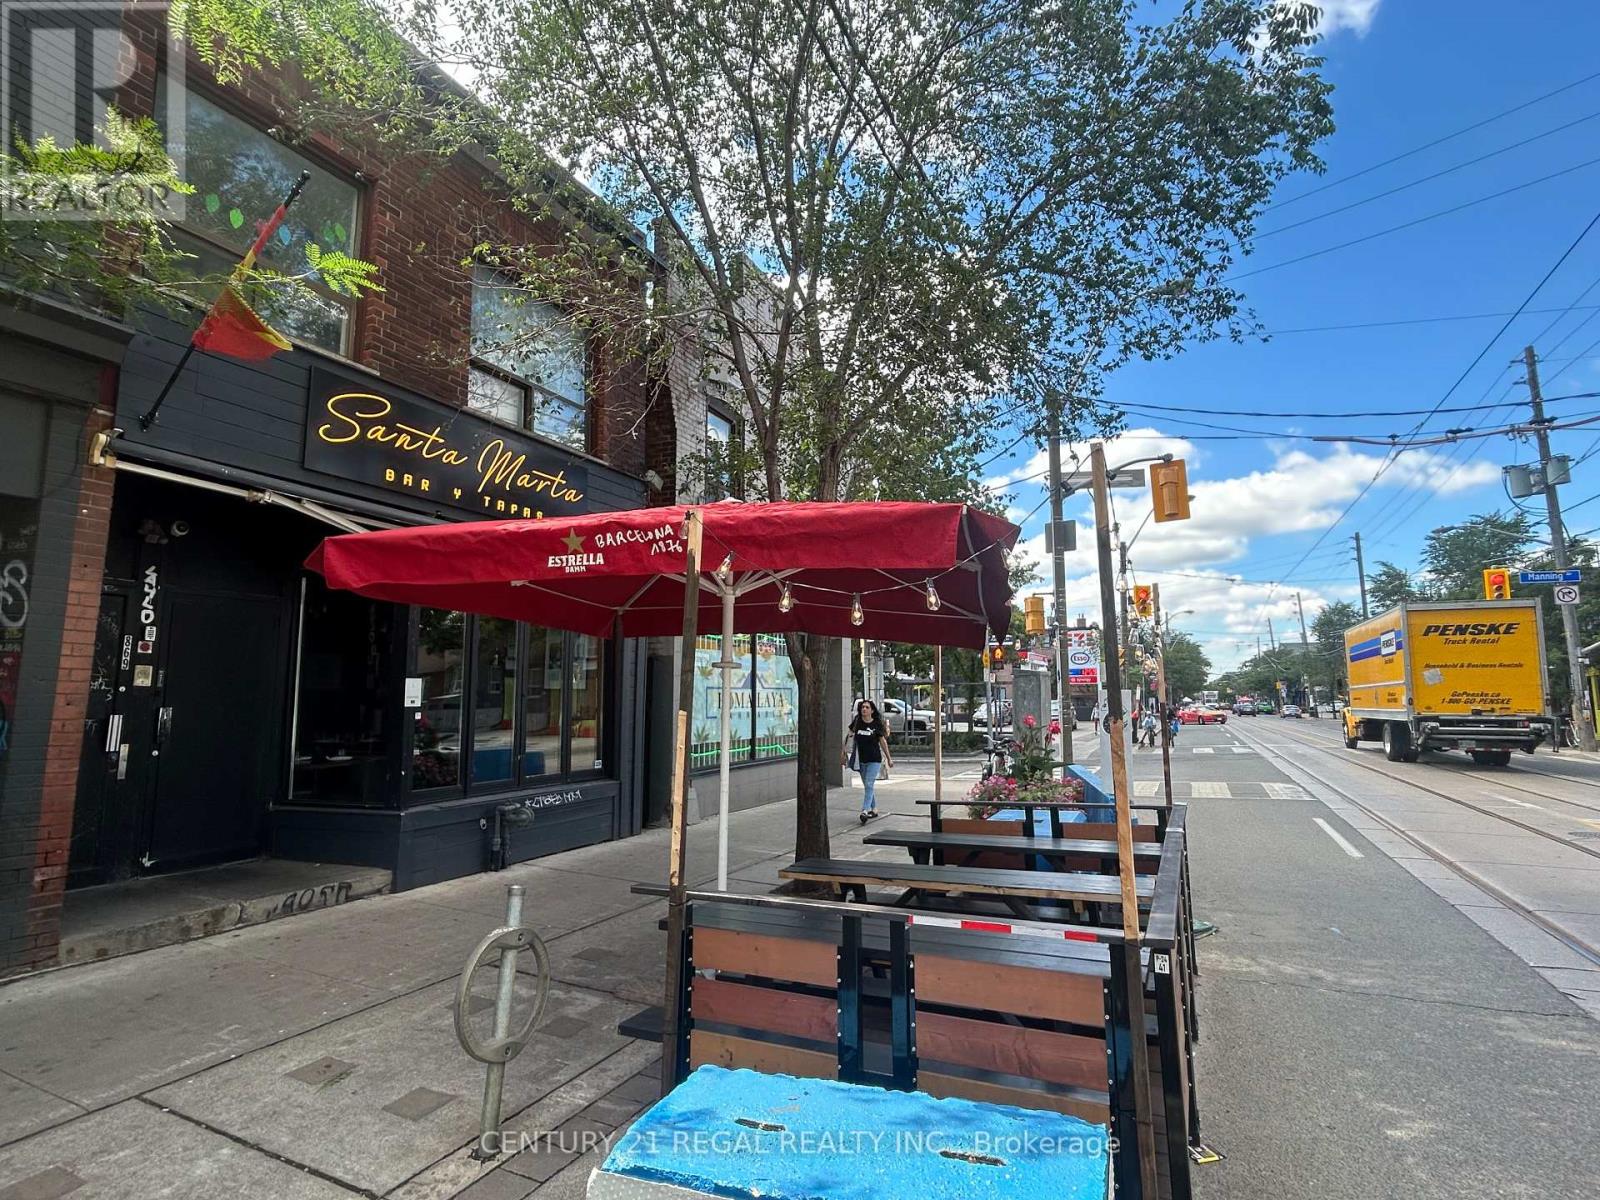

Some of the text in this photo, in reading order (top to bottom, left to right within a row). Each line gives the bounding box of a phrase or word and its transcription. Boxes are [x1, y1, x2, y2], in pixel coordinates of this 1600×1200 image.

[318, 393, 584, 502] Santa Marta
[385, 468, 431, 491] BAR
[595, 524, 674, 548] BARCELONA
[650, 540, 683, 556] 1876
[547, 552, 605, 568] ESTRELLA
[1528, 573, 1563, 582] Manning
[1423, 622, 1520, 636] PENSKE
[1443, 637, 1501, 645] Truck Rental
[121, 635, 132, 670] 869
